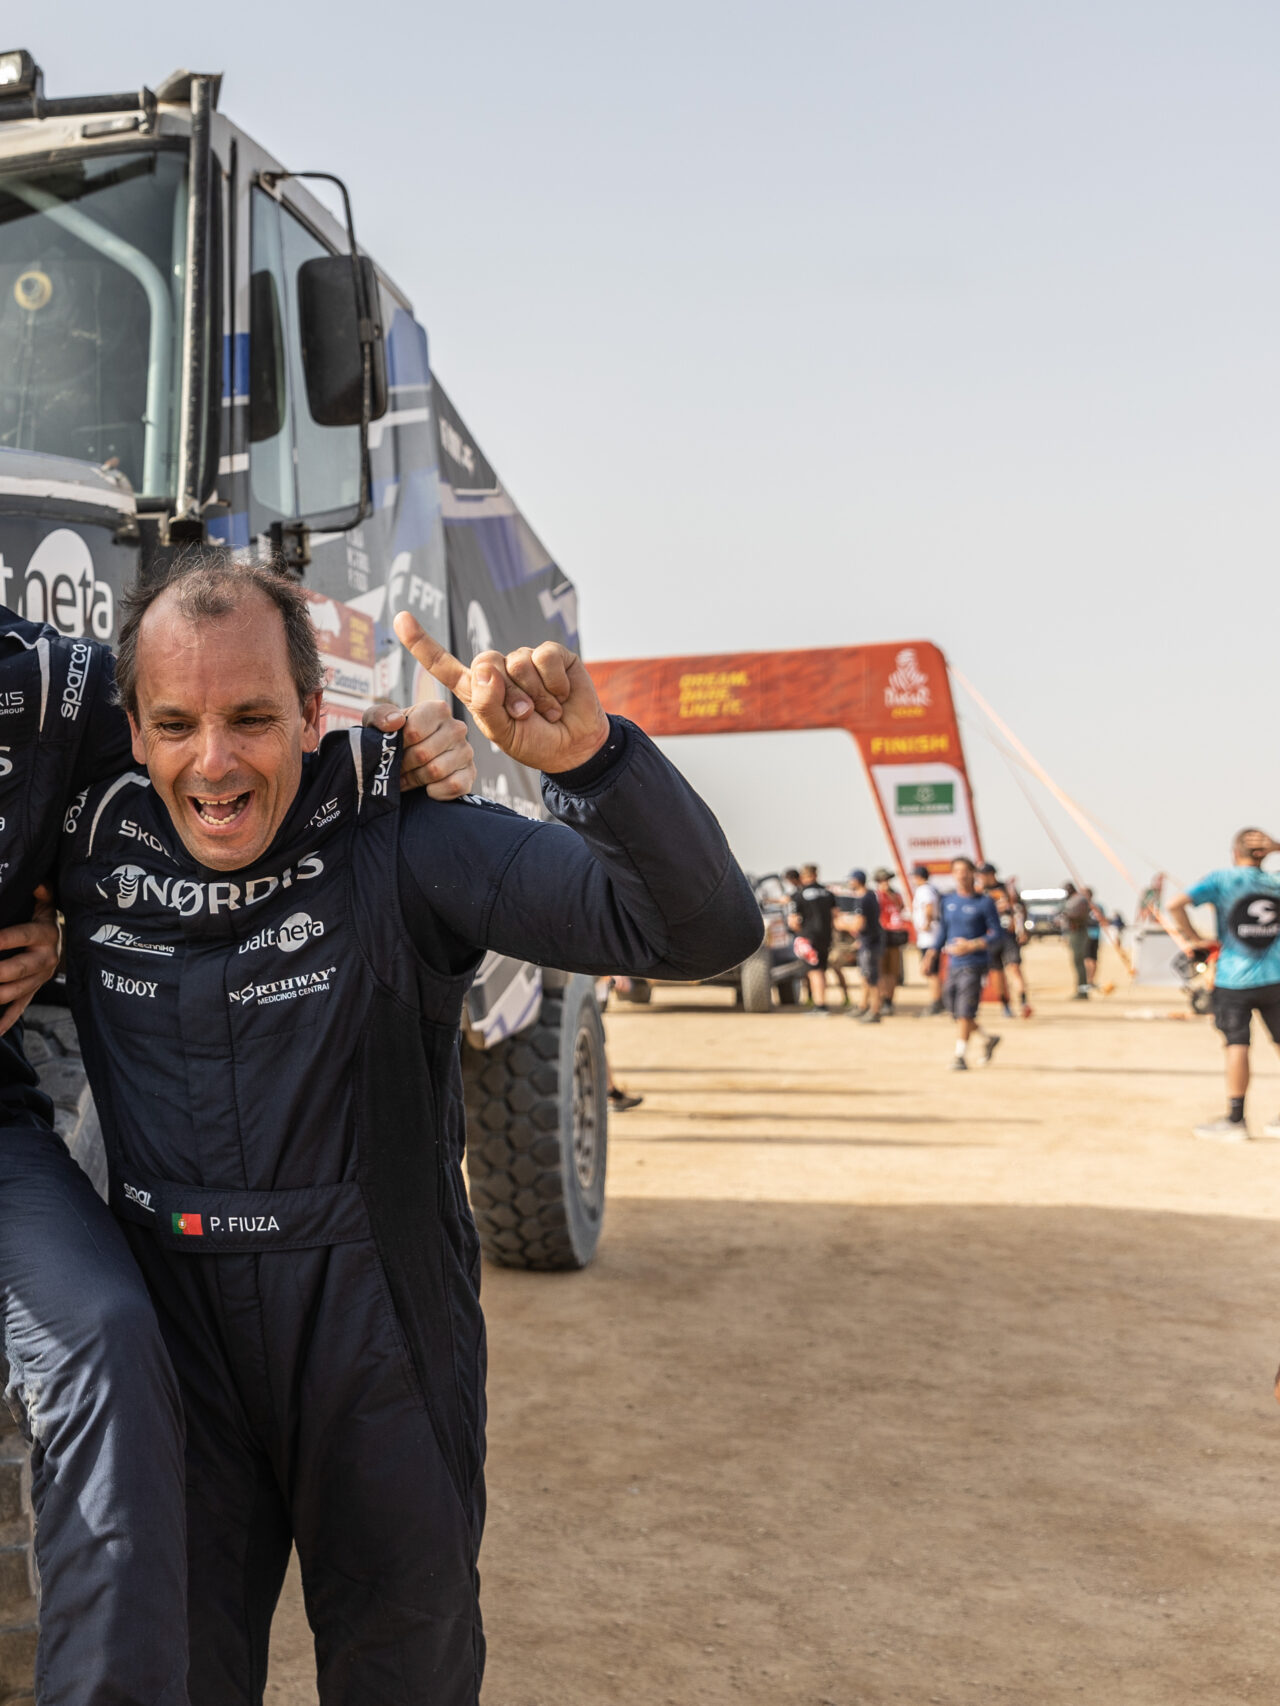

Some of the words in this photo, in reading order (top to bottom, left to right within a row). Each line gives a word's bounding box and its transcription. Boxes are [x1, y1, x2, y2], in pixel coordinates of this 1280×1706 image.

[408, 574, 445, 619] FPT
[61, 644, 89, 719] sparco
[871, 734, 948, 755] FINISH
[316, 810, 340, 828] GROUP
[101, 969, 115, 989] DE
[115, 976, 158, 997] ROOY
[257, 990, 297, 1005] MEDICINOS
[210, 1216, 224, 1231] P.
[228, 1216, 280, 1232] FIUZA
